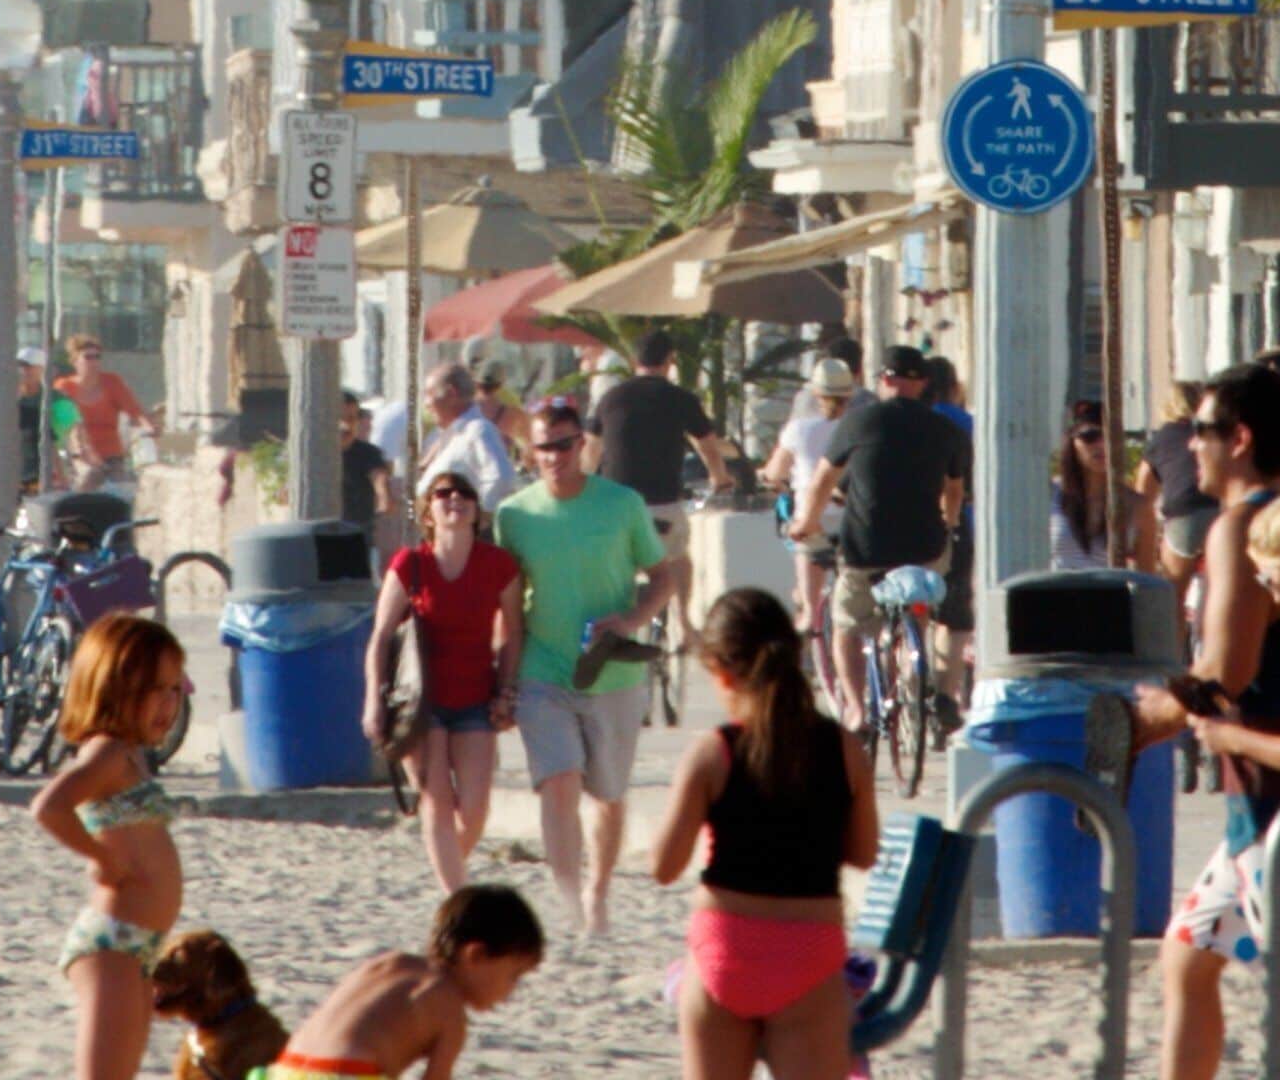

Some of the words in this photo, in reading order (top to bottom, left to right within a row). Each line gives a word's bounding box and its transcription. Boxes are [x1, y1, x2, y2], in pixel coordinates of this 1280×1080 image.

[352, 61, 403, 89] 30TH
[403, 62, 492, 91] STREET
[995, 125, 1044, 138] SHARE
[69, 134, 136, 157] STREET
[985, 142, 1010, 155] THE
[1015, 142, 1057, 155] PATH
[309, 162, 332, 201] 8
